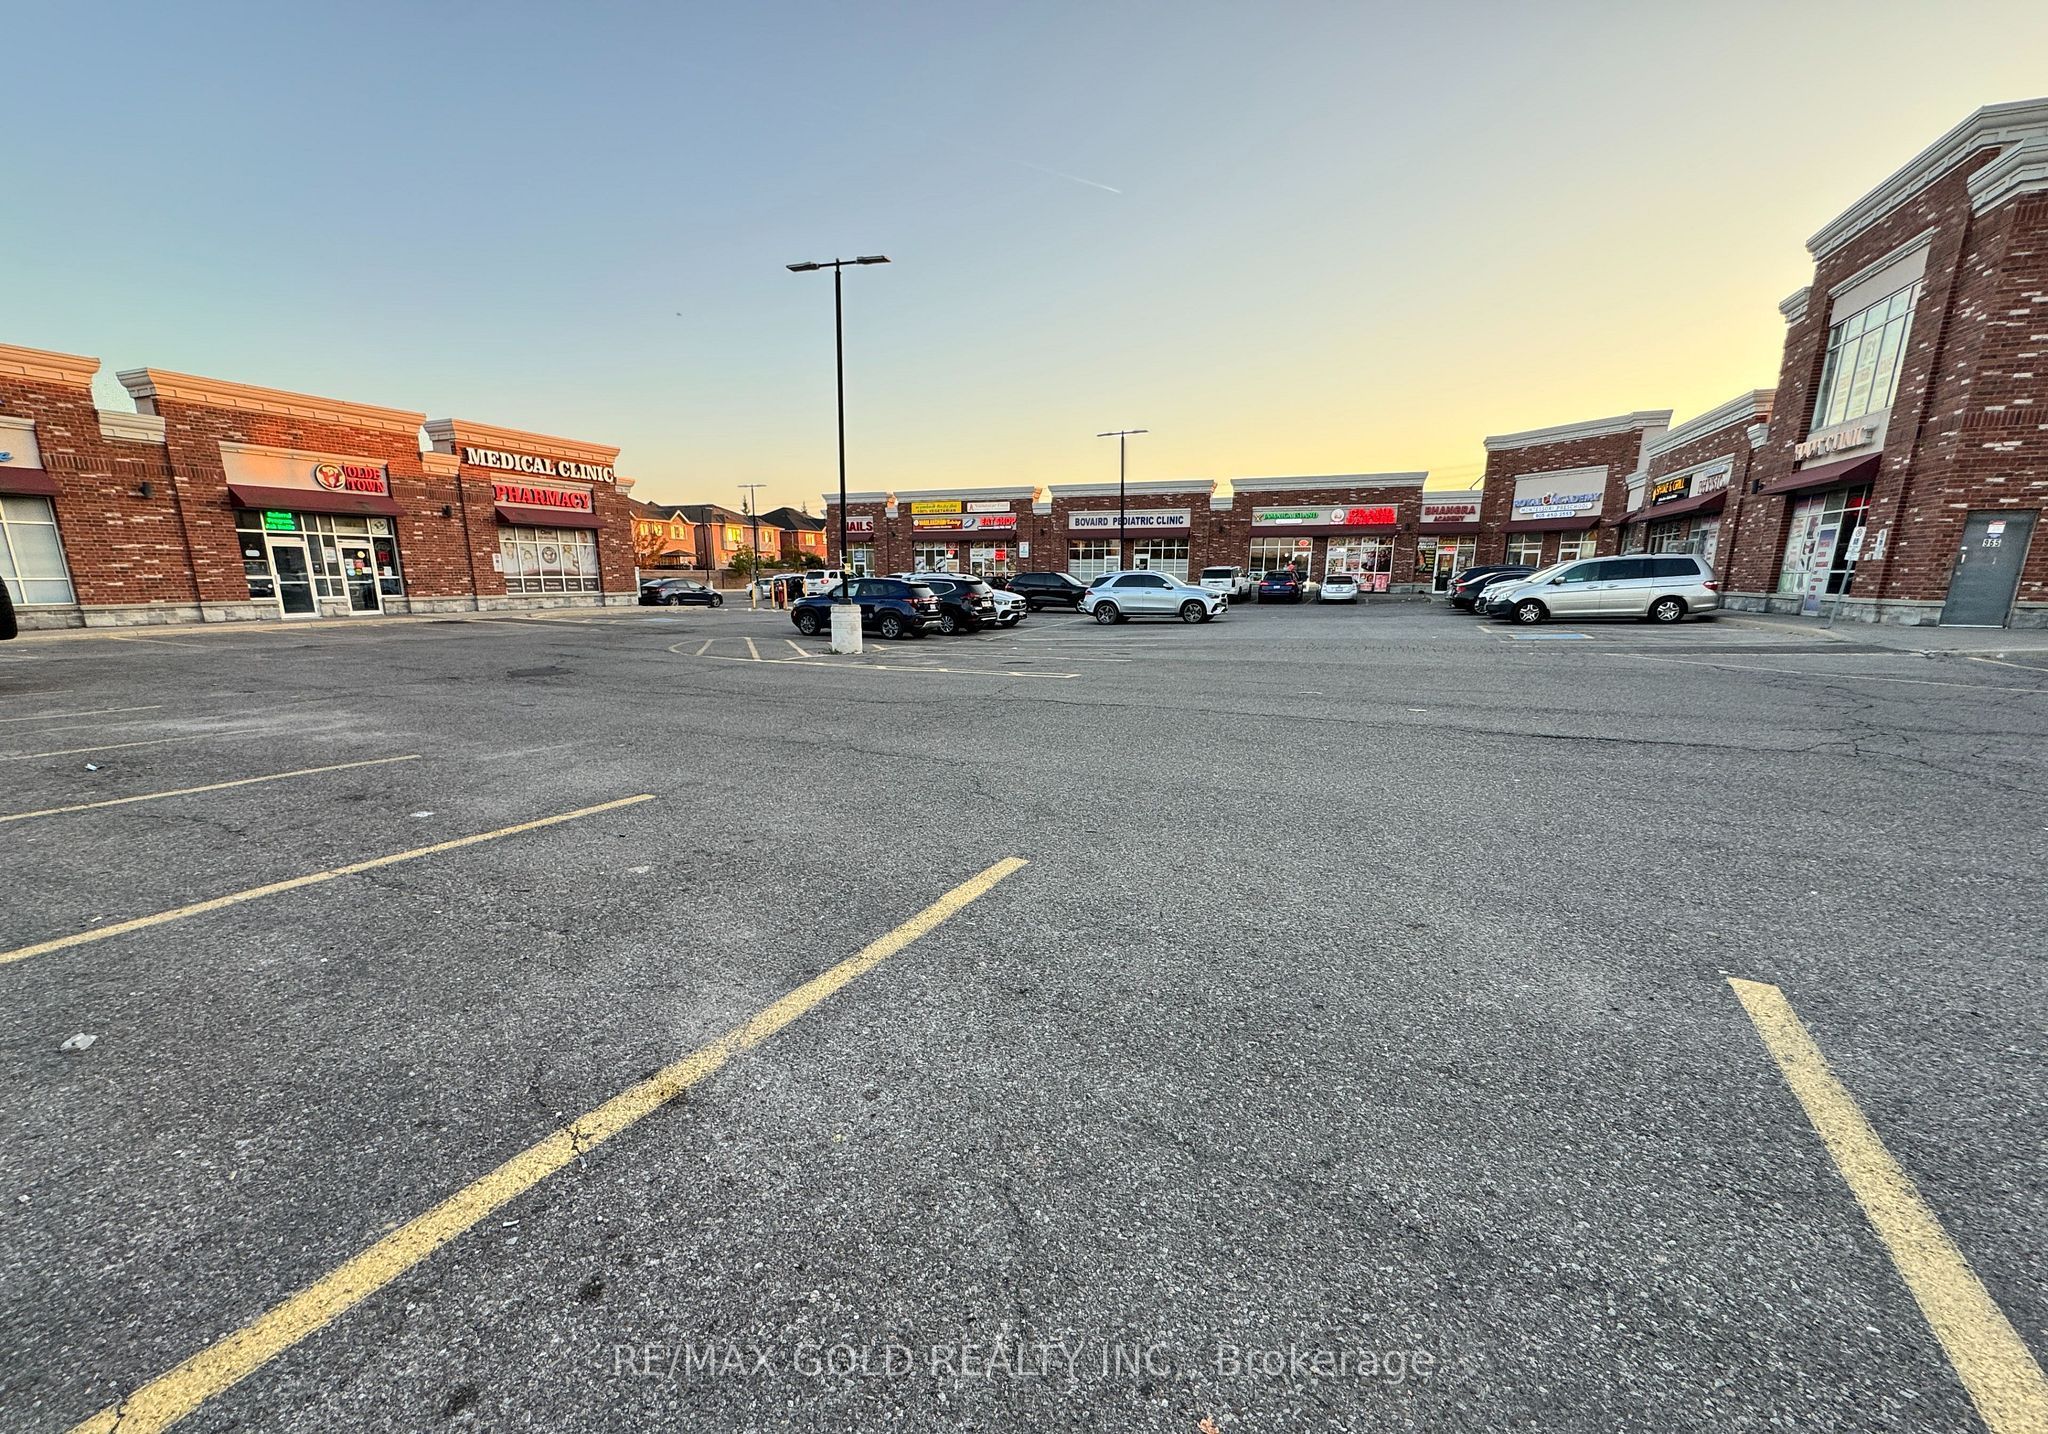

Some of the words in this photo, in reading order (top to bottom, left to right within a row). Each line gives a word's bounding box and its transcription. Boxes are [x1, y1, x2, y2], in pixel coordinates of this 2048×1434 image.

[465, 446, 557, 477] MEDICAL
[557, 460, 615, 483] CLINIC
[345, 464, 383, 480] OLDE
[347, 479, 386, 493] TOWN
[493, 484, 591, 509] PHARMACY
[1551, 491, 1603, 505] ACADEMY
[1424, 505, 1476, 516] BHANGRA
[1556, 503, 1591, 511] PRESCHOOL
[1074, 517, 1109, 527] BOVAIRD
[1112, 516, 1155, 526] PEDIATRIC
[1156, 515, 1185, 525] CLINIC
[1983, 539, 2001, 548] 965
